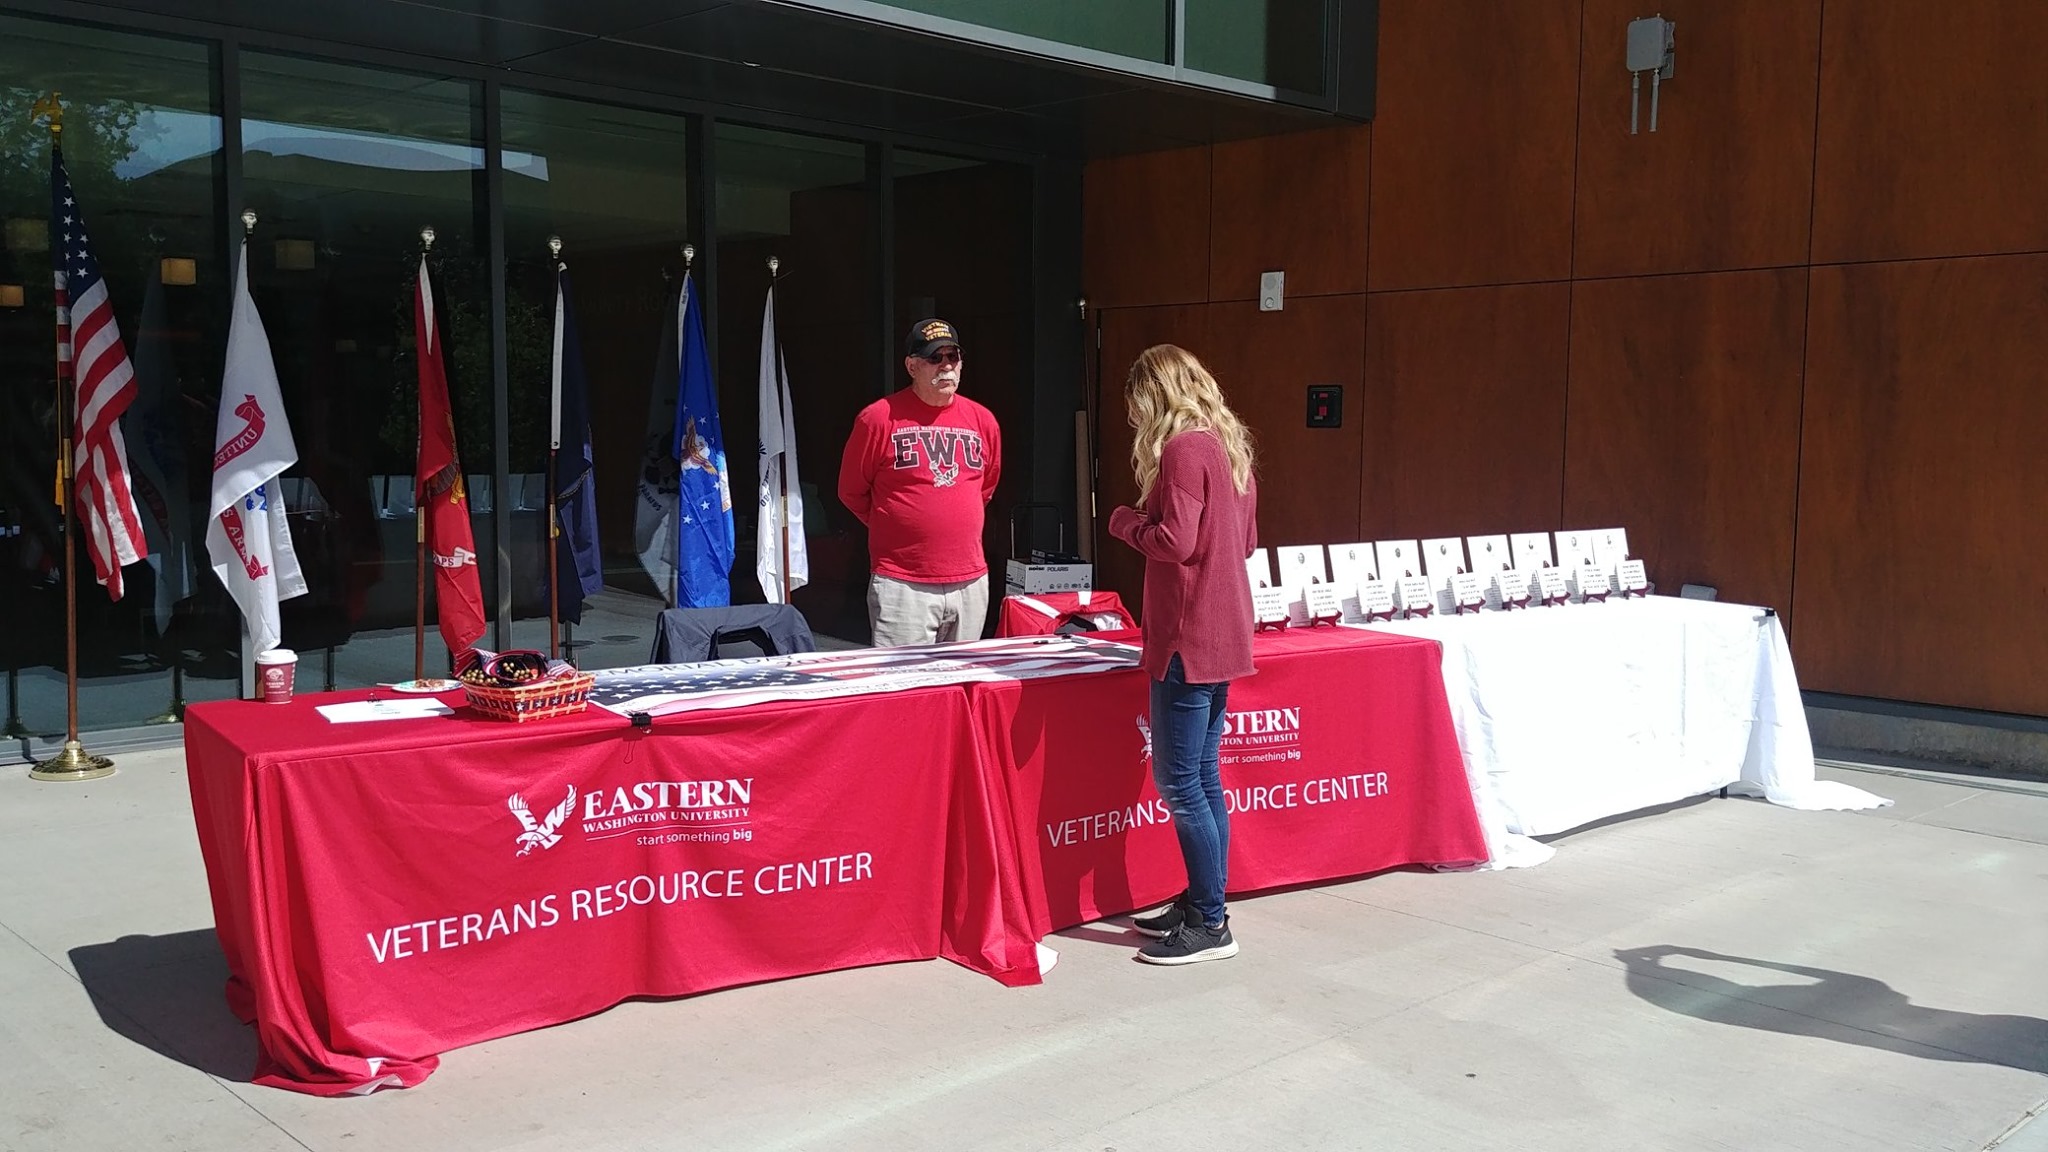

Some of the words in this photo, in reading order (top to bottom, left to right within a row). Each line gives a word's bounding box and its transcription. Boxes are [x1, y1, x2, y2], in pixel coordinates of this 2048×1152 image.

[892, 430, 984, 470] EWU
[1222, 707, 1300, 736] STERN
[1246, 732, 1299, 745] UNIVERSITY
[1220, 755, 1239, 765] start
[1241, 751, 1286, 764] something
[1287, 749, 1301, 760] big
[582, 778, 754, 821] EASTERN
[1047, 799, 1171, 848] VETERANS
[1224, 783, 1297, 815] OURCE
[1303, 771, 1389, 806] CENTER
[582, 811, 667, 833] WASHINGTON
[671, 807, 750, 822] UNIVERSITY
[636, 834, 664, 846] start
[666, 829, 730, 844] something
[732, 828, 753, 842] big
[367, 894, 560, 963] VETERANS
[571, 869, 744, 921] RESOURCE
[754, 852, 873, 895] CENTER
